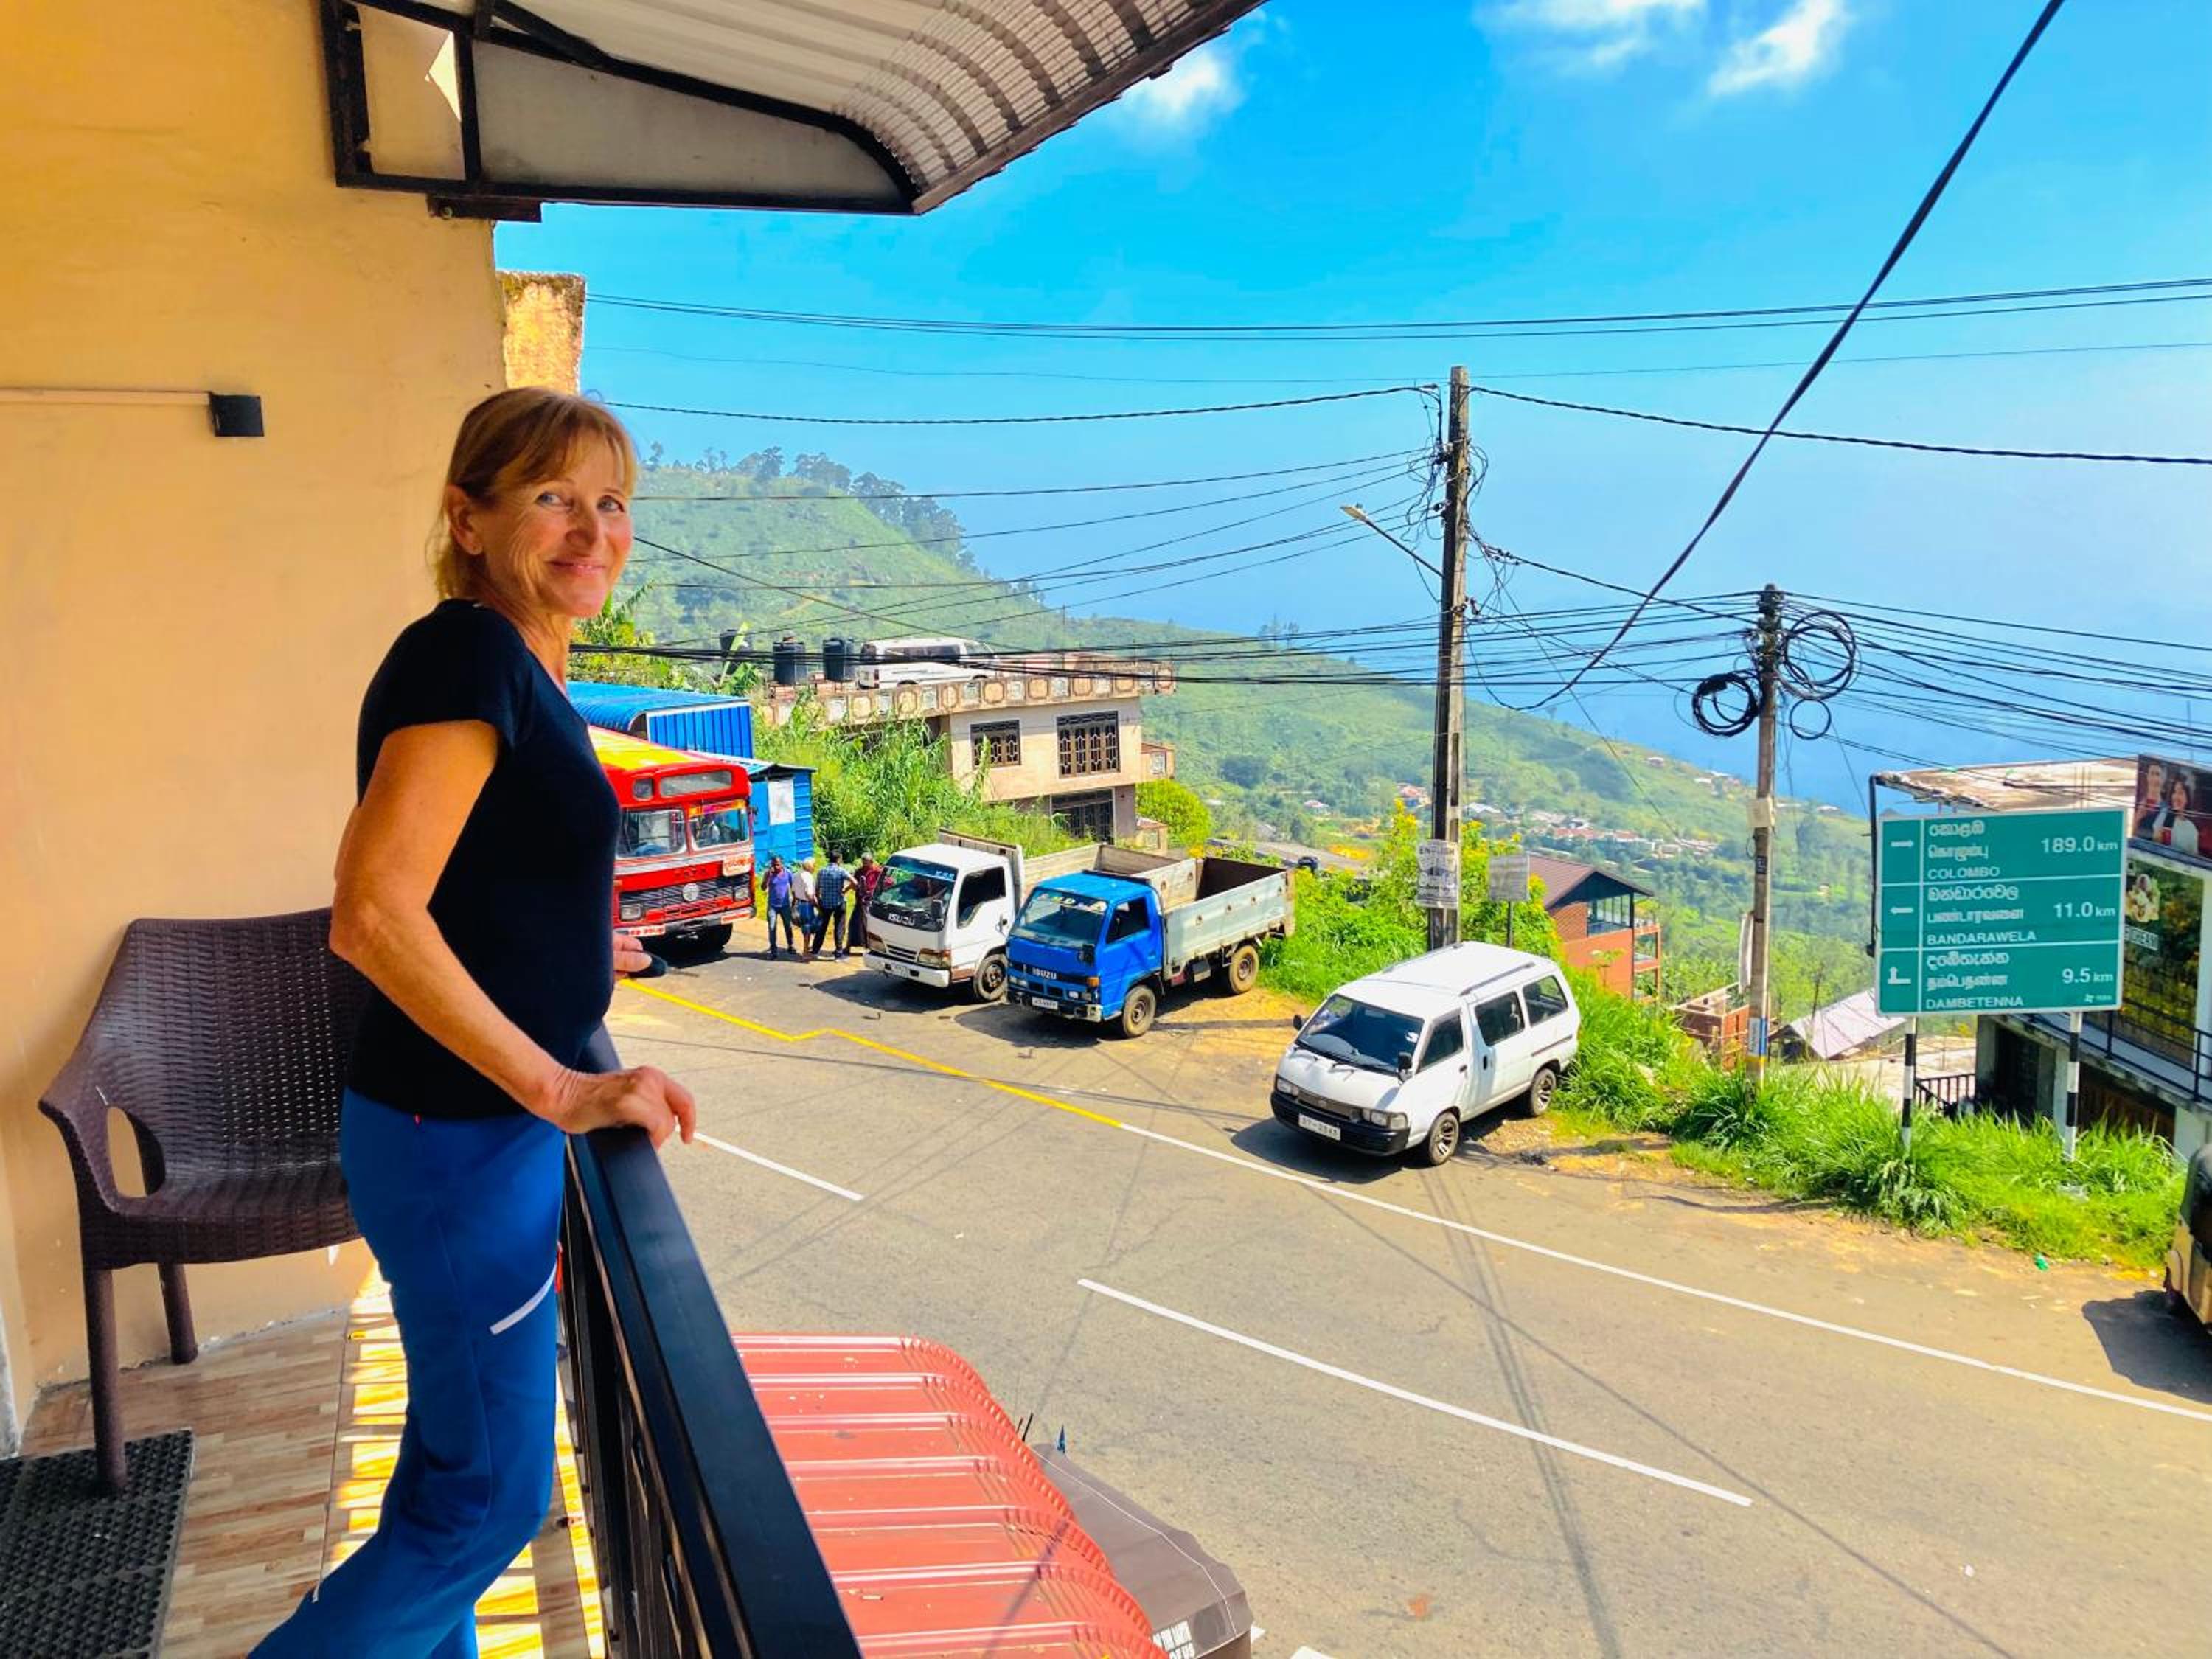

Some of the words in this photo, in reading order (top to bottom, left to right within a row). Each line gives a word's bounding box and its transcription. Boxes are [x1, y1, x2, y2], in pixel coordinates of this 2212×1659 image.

[2041, 836, 2096, 853] 189.0
[2097, 841, 2118, 852] km
[1927, 866, 2000, 880] COLOMBO
[2053, 902, 2093, 918] 11.0
[2095, 906, 2116, 917] km
[888, 913, 916, 926] ISUZU
[1927, 931, 2037, 945] BANDARAWELA
[1032, 967, 1057, 980] ISUZU
[2062, 967, 2090, 984] 9.5
[2093, 972, 2114, 983] km
[1926, 996, 2024, 1010] DAMBETENNA
